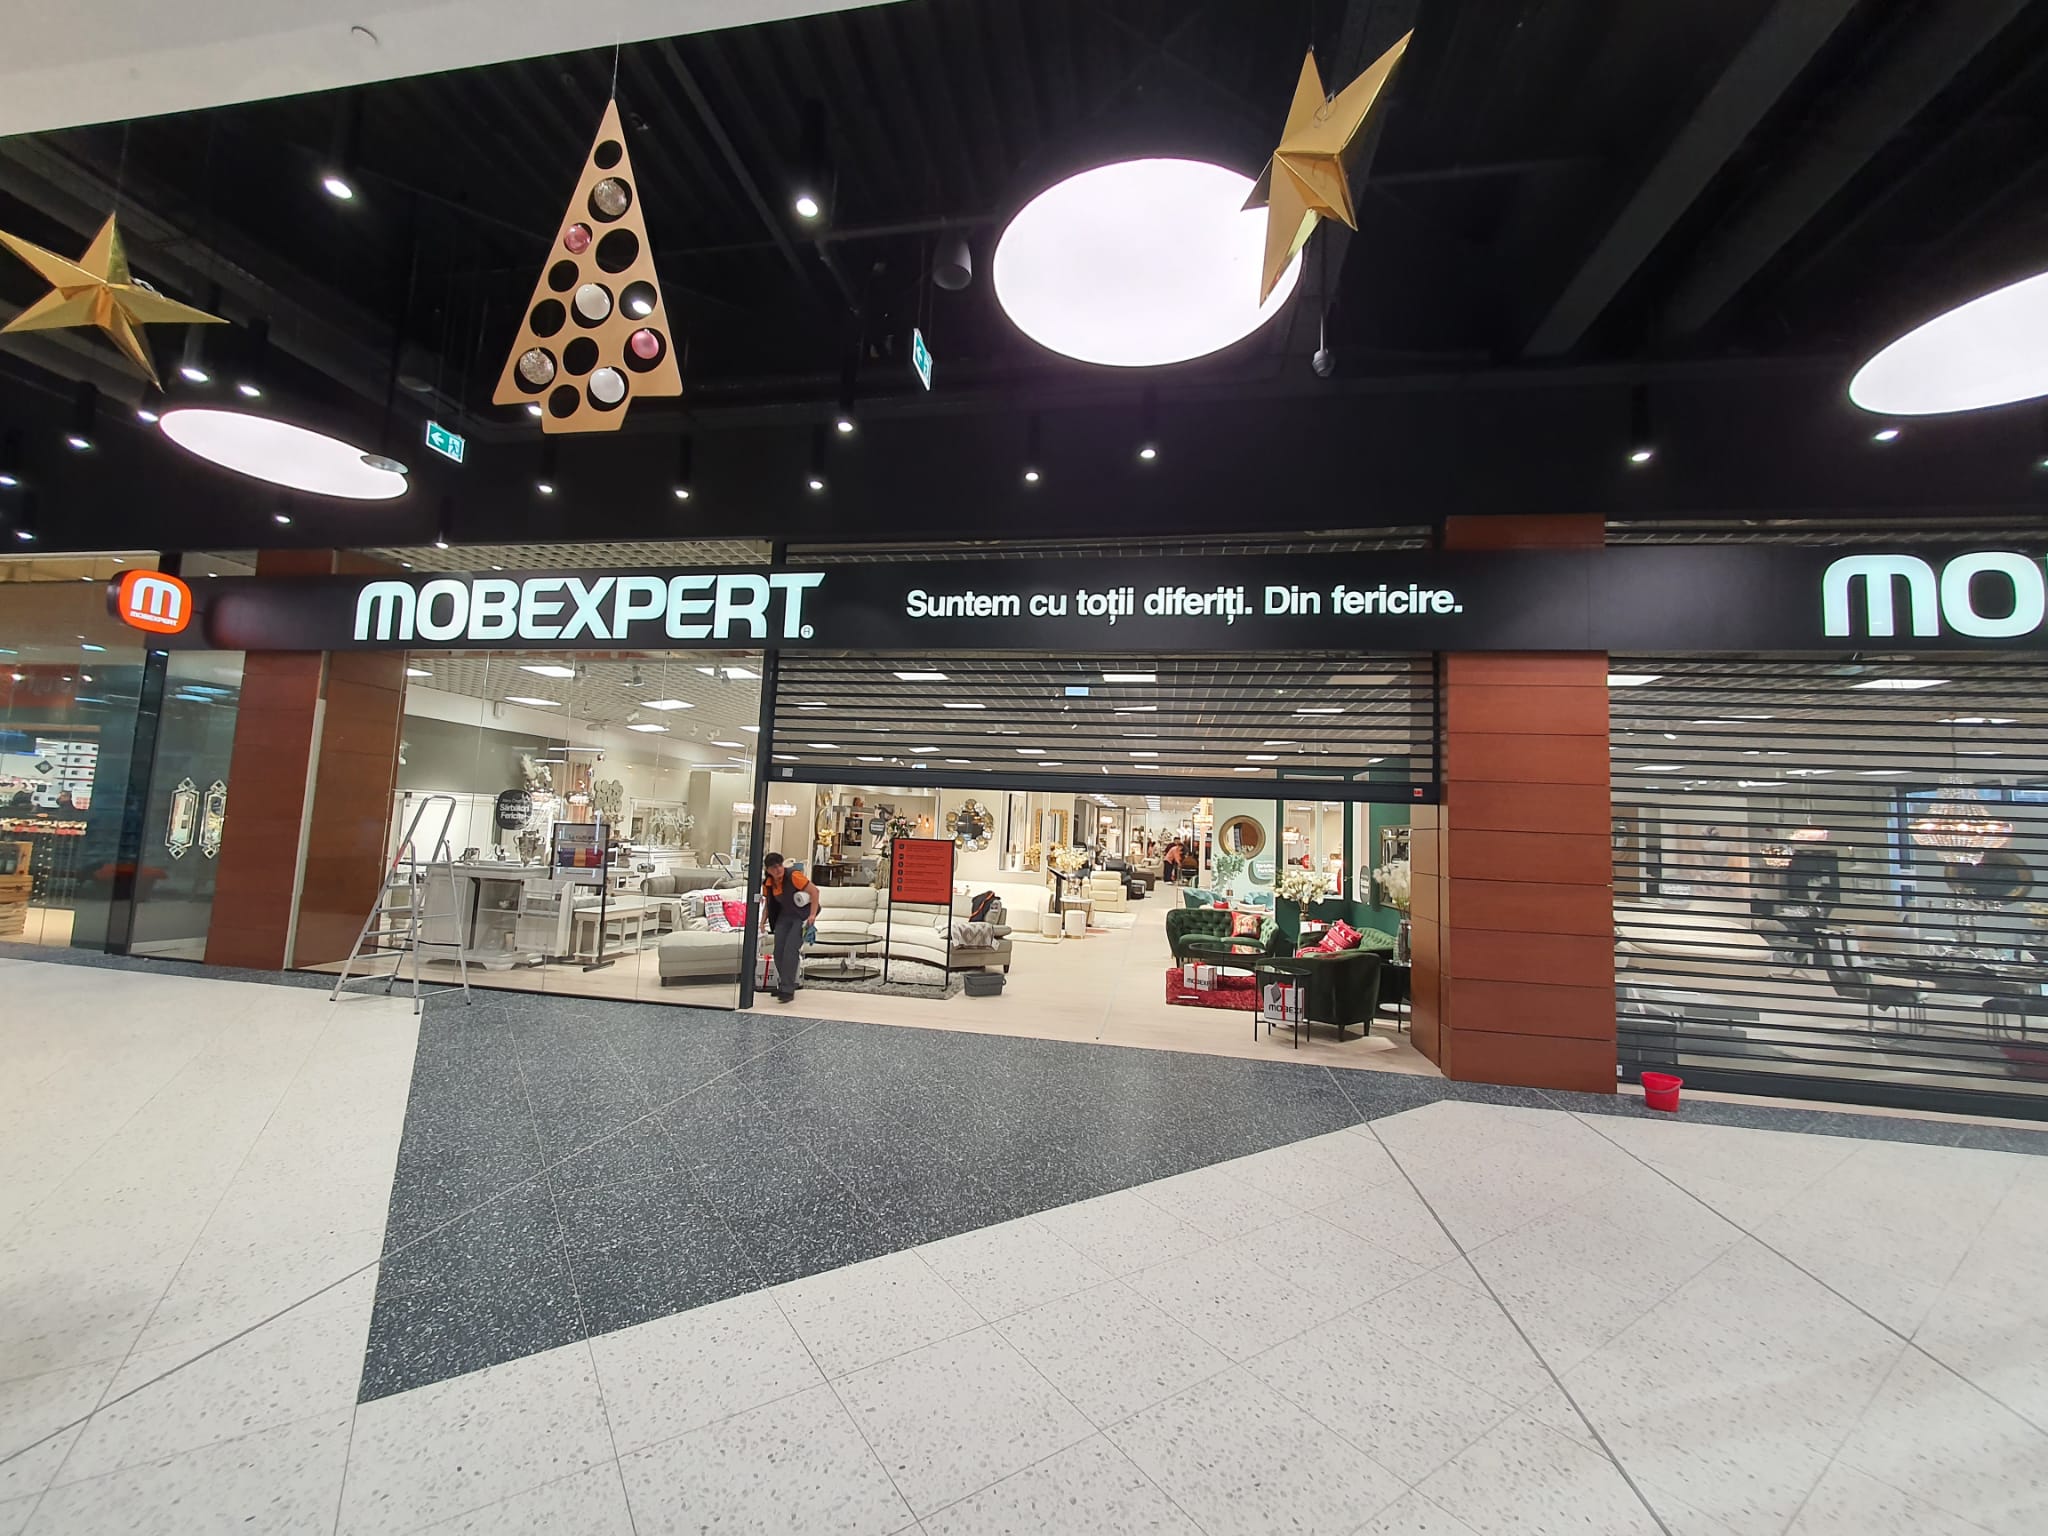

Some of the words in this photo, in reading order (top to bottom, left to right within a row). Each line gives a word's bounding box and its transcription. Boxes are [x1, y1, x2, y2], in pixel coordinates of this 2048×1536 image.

[906, 589, 1020, 618] Suntem
[1029, 594, 1067, 616] cu
[1264, 586, 1321, 615] Din
[1331, 584, 1463, 614] fericire.
[1824, 551, 2048, 638] MO
